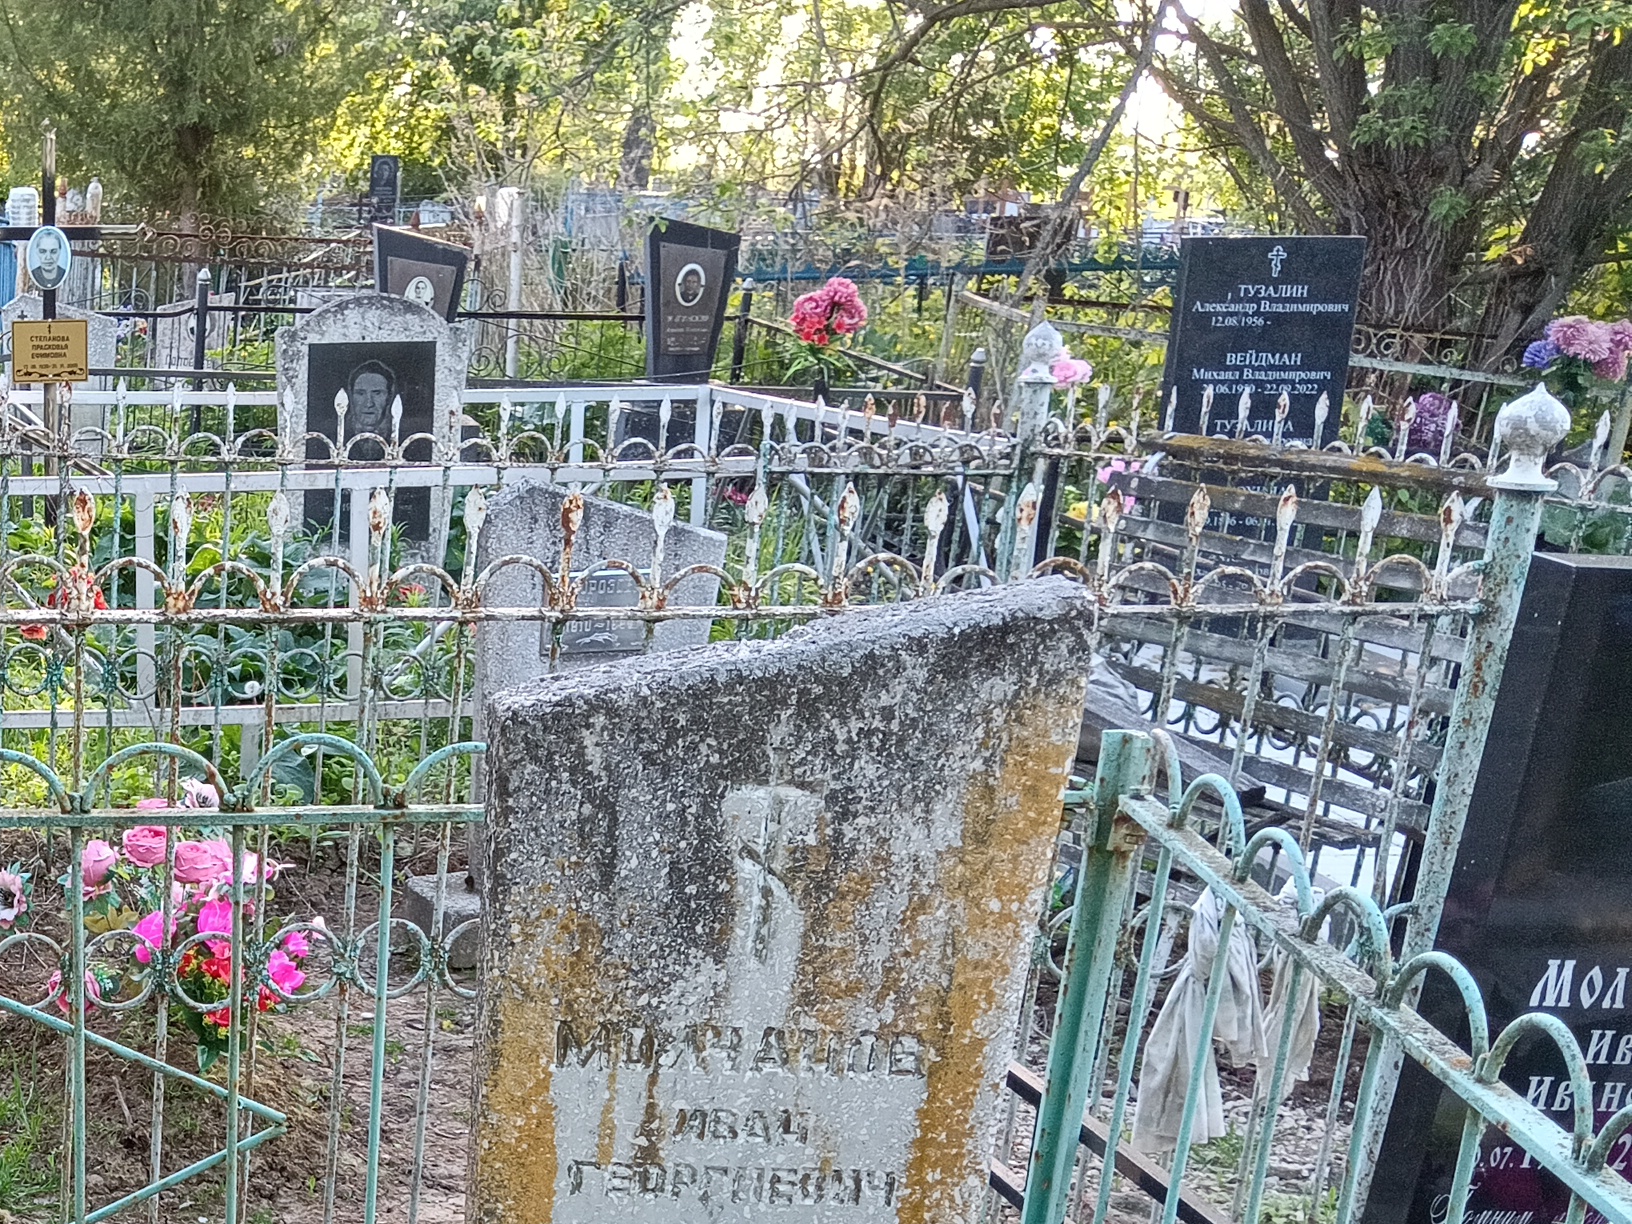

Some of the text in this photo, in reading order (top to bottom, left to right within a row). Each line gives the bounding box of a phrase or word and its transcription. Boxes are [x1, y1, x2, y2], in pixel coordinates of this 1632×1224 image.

[1238, 284, 1309, 298] ТУЗАЛИН
[1192, 300, 1350, 315] Александр Владимирович
[1226, 350, 1302, 367] ВЕЙДМАН
[1243, 368, 1331, 382] Владимирович
[1214, 419, 1294, 432] ТУЗАЛИА
[672, 1107, 809, 1145] ИВАН
[567, 1159, 898, 1208] ГЕОРГИЕВИЧ
